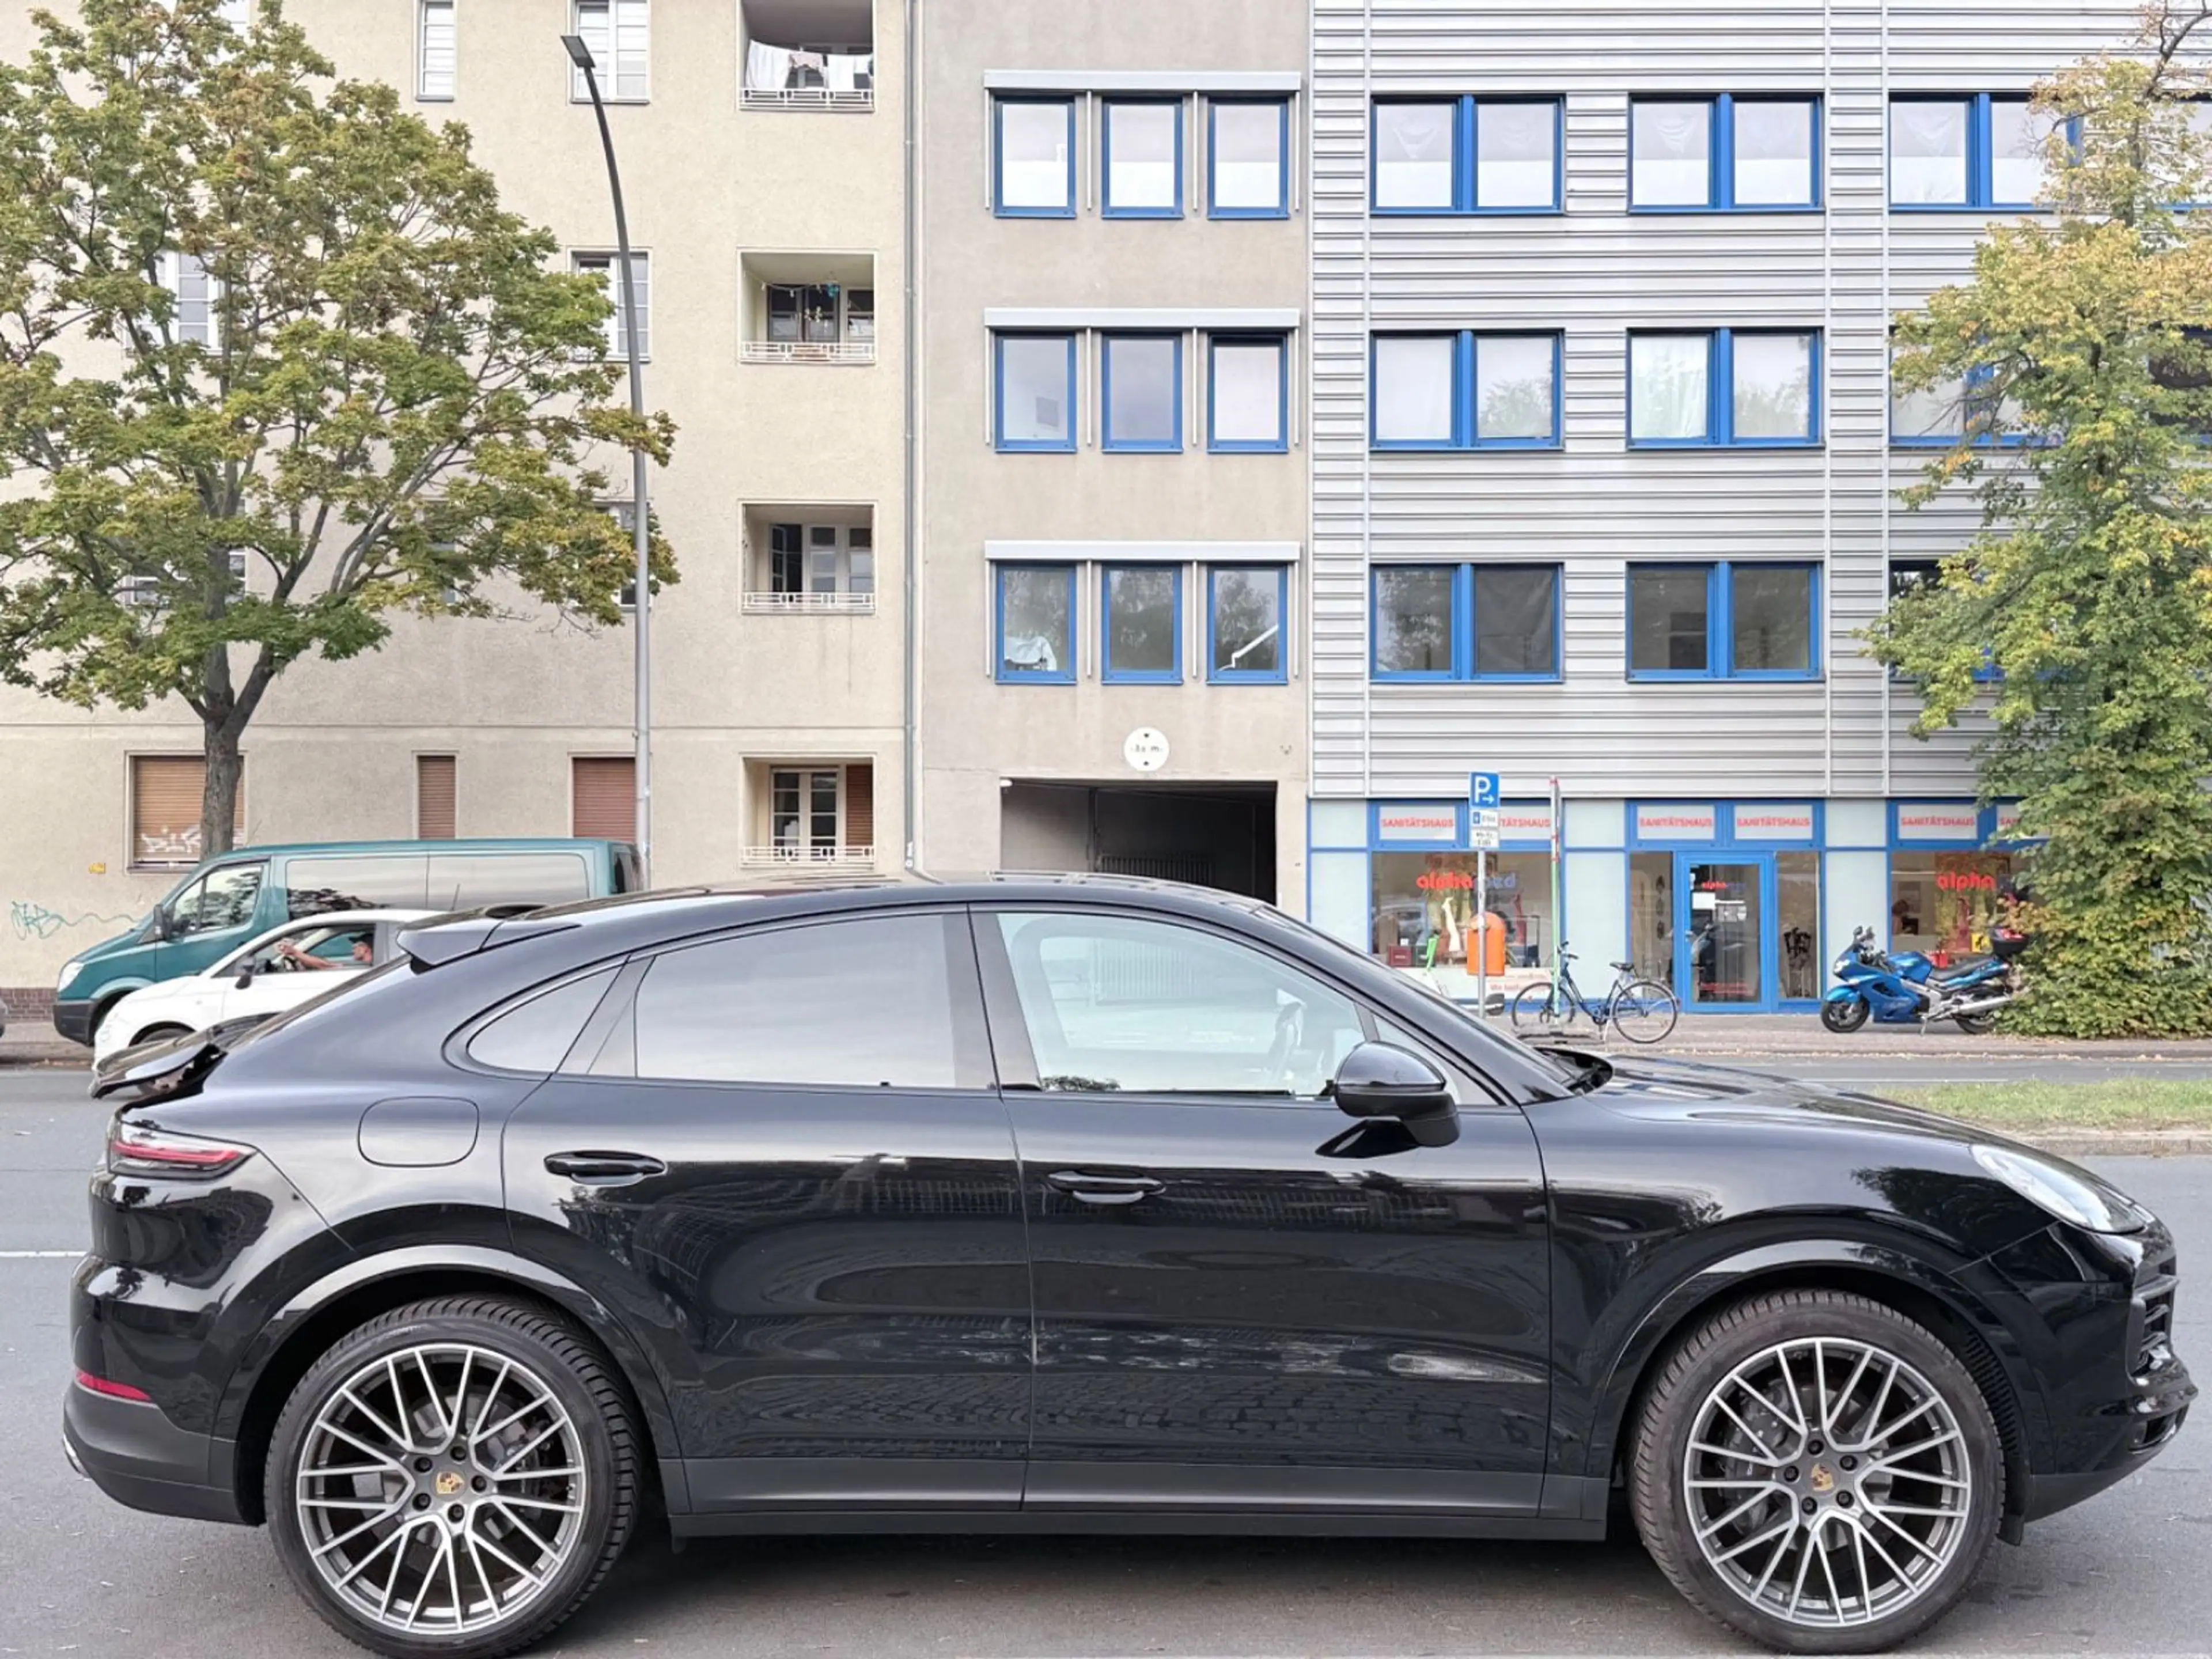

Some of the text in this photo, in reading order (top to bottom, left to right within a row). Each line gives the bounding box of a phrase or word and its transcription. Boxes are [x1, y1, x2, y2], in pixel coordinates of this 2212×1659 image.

[1475, 776, 1491, 803] P
[1382, 817, 1453, 828] SANITÄTSHAUS
[1640, 817, 1712, 827] SANITÄTSHAUS
[1737, 816, 1810, 827] SANITÄTSHAUS
[1902, 816, 1974, 827] SANITÄTSHAUS
